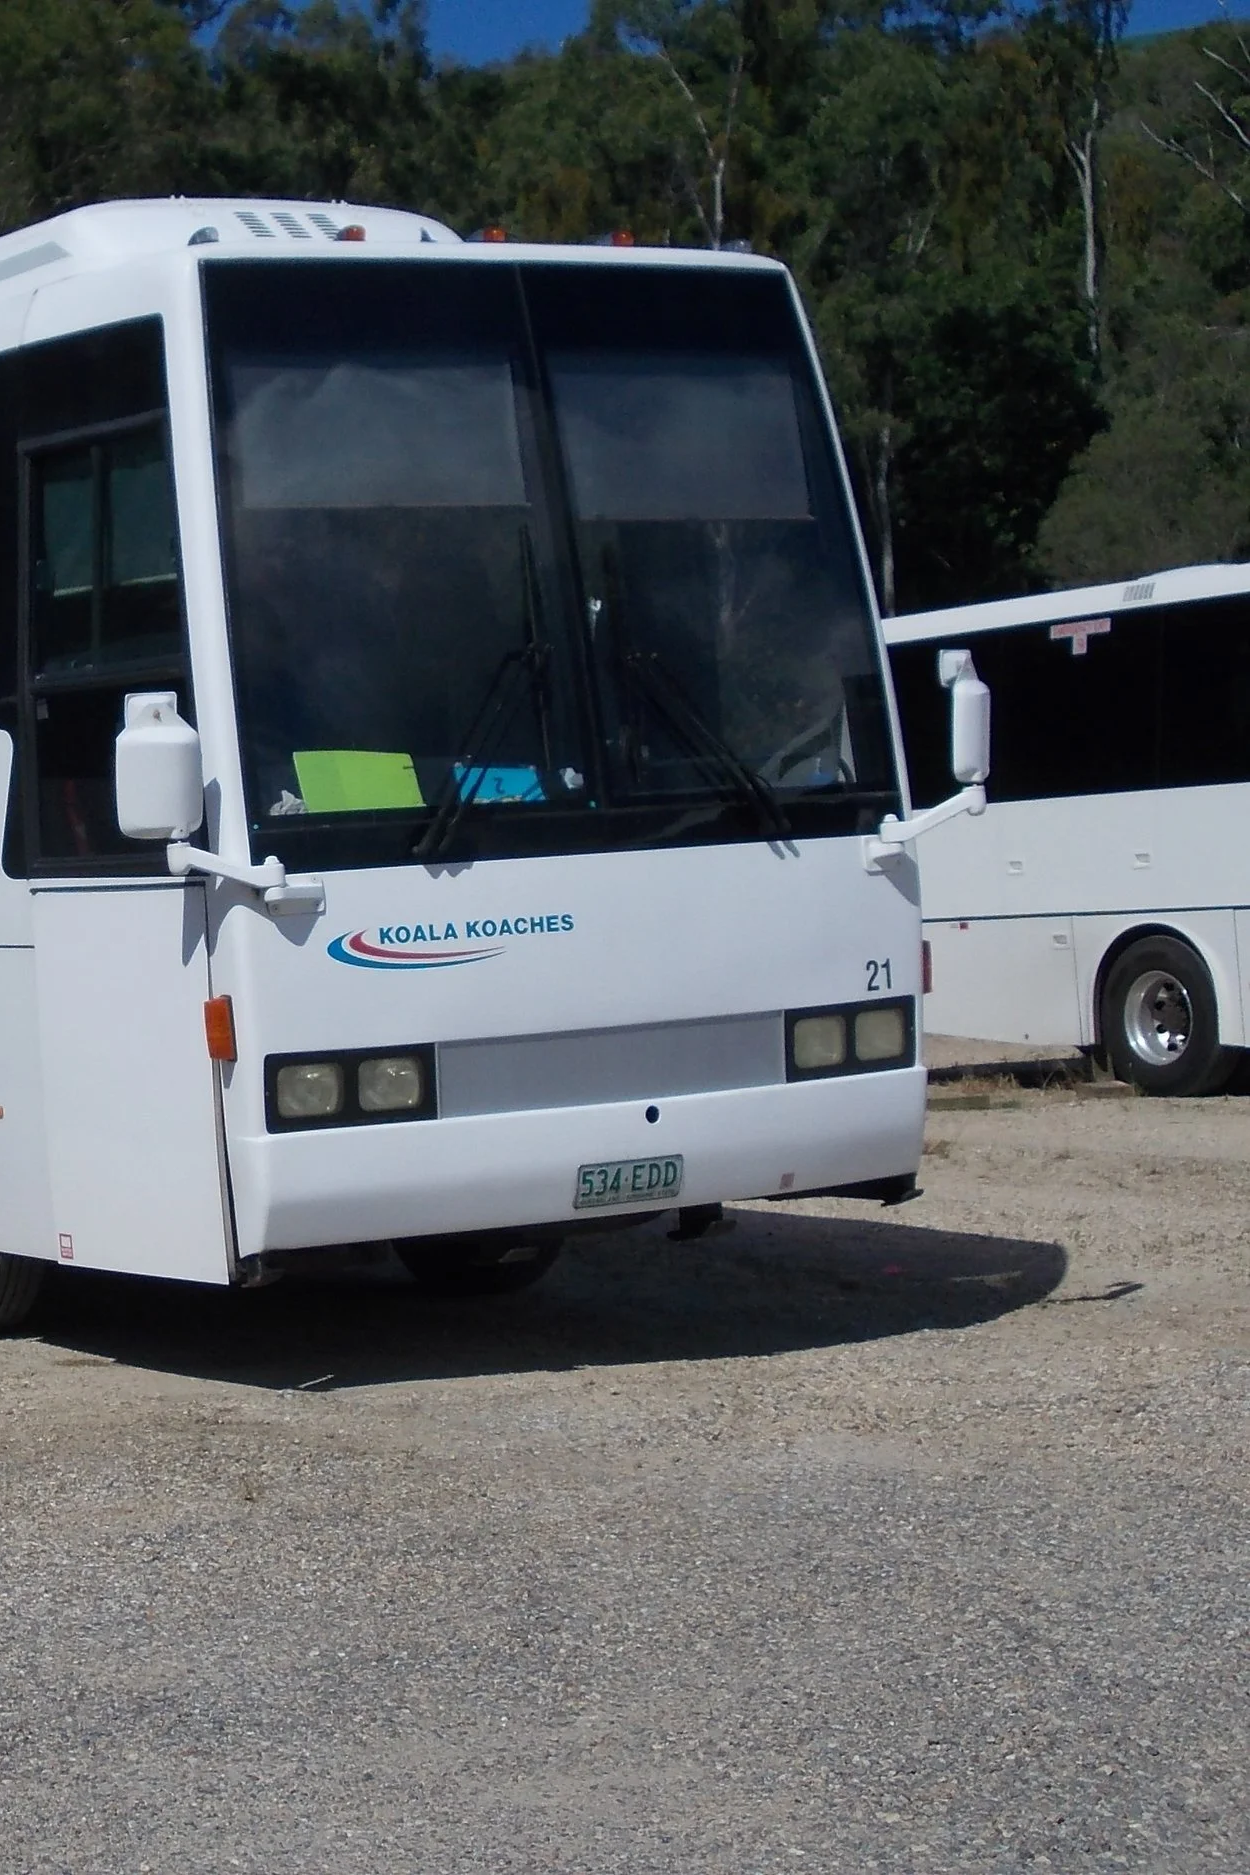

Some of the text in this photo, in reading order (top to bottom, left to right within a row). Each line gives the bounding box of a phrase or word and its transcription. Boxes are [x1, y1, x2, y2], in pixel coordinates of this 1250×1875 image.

[379, 914, 574, 944] KOALA KOACHES
[866, 958, 892, 991] 21
[580, 1167, 623, 1197] 534
[631, 1161, 678, 1191] EDD
